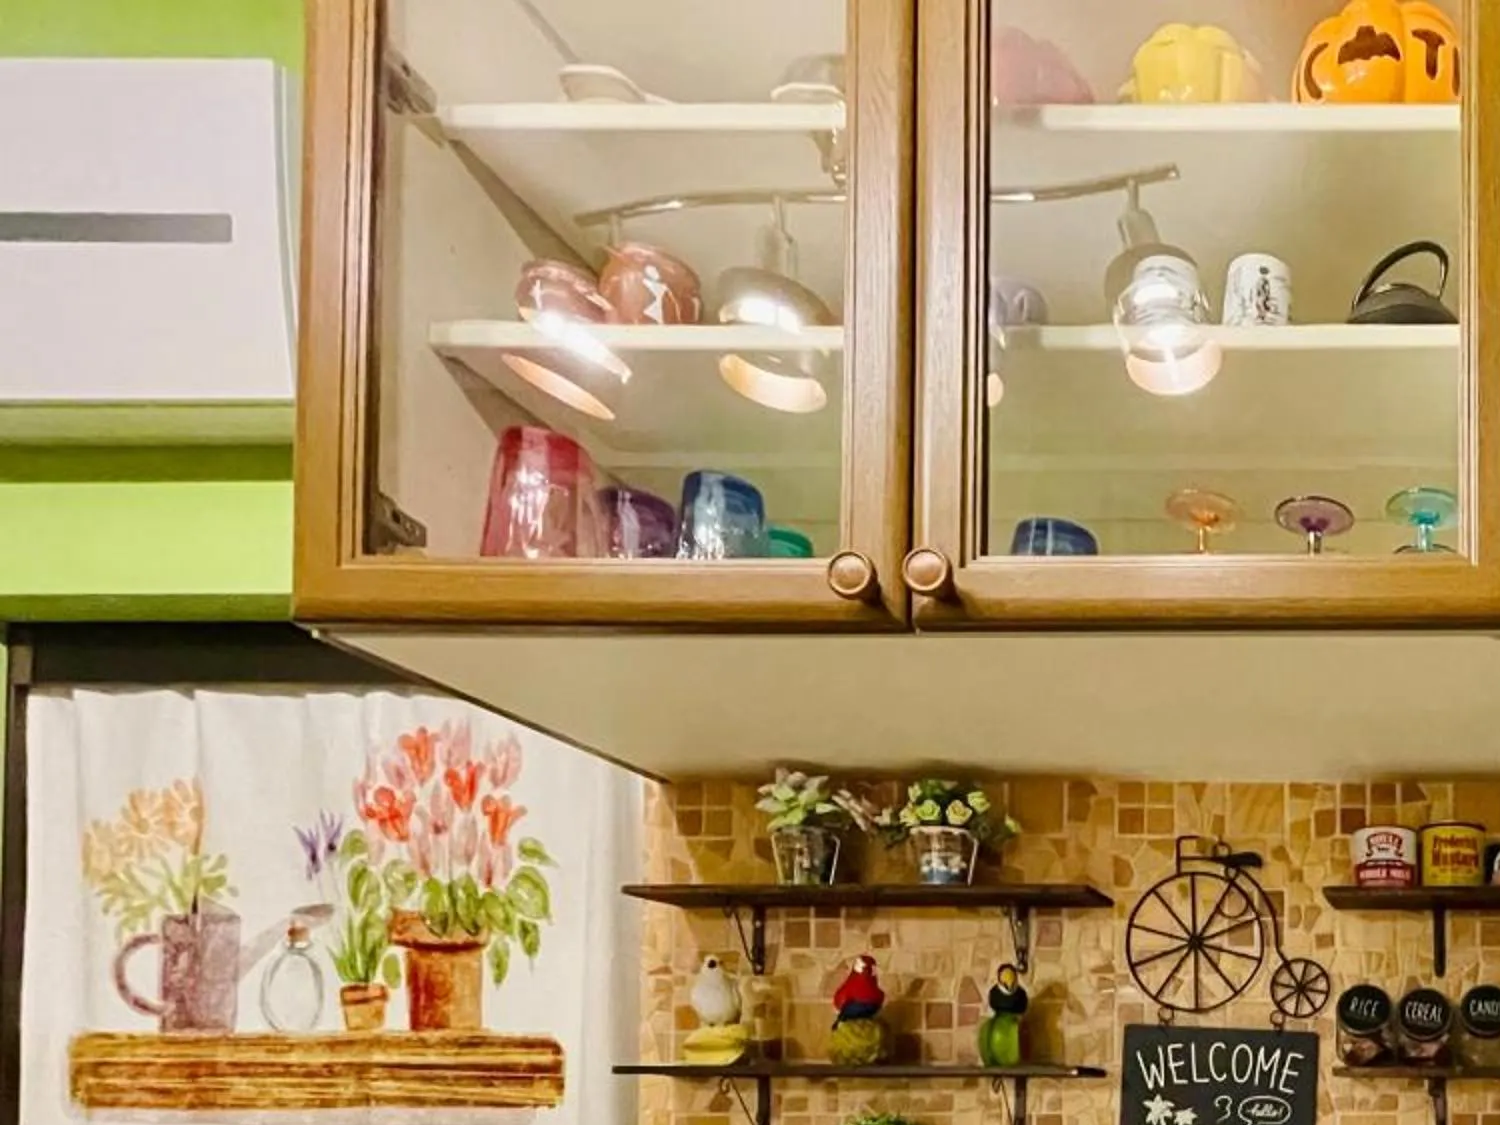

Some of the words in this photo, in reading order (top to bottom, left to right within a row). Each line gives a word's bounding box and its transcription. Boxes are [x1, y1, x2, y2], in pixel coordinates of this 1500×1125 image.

[1350, 996, 1379, 1018] RICE
[1405, 1000, 1443, 1023] CEREAL
[1136, 1041, 1305, 1095] WELCOME
